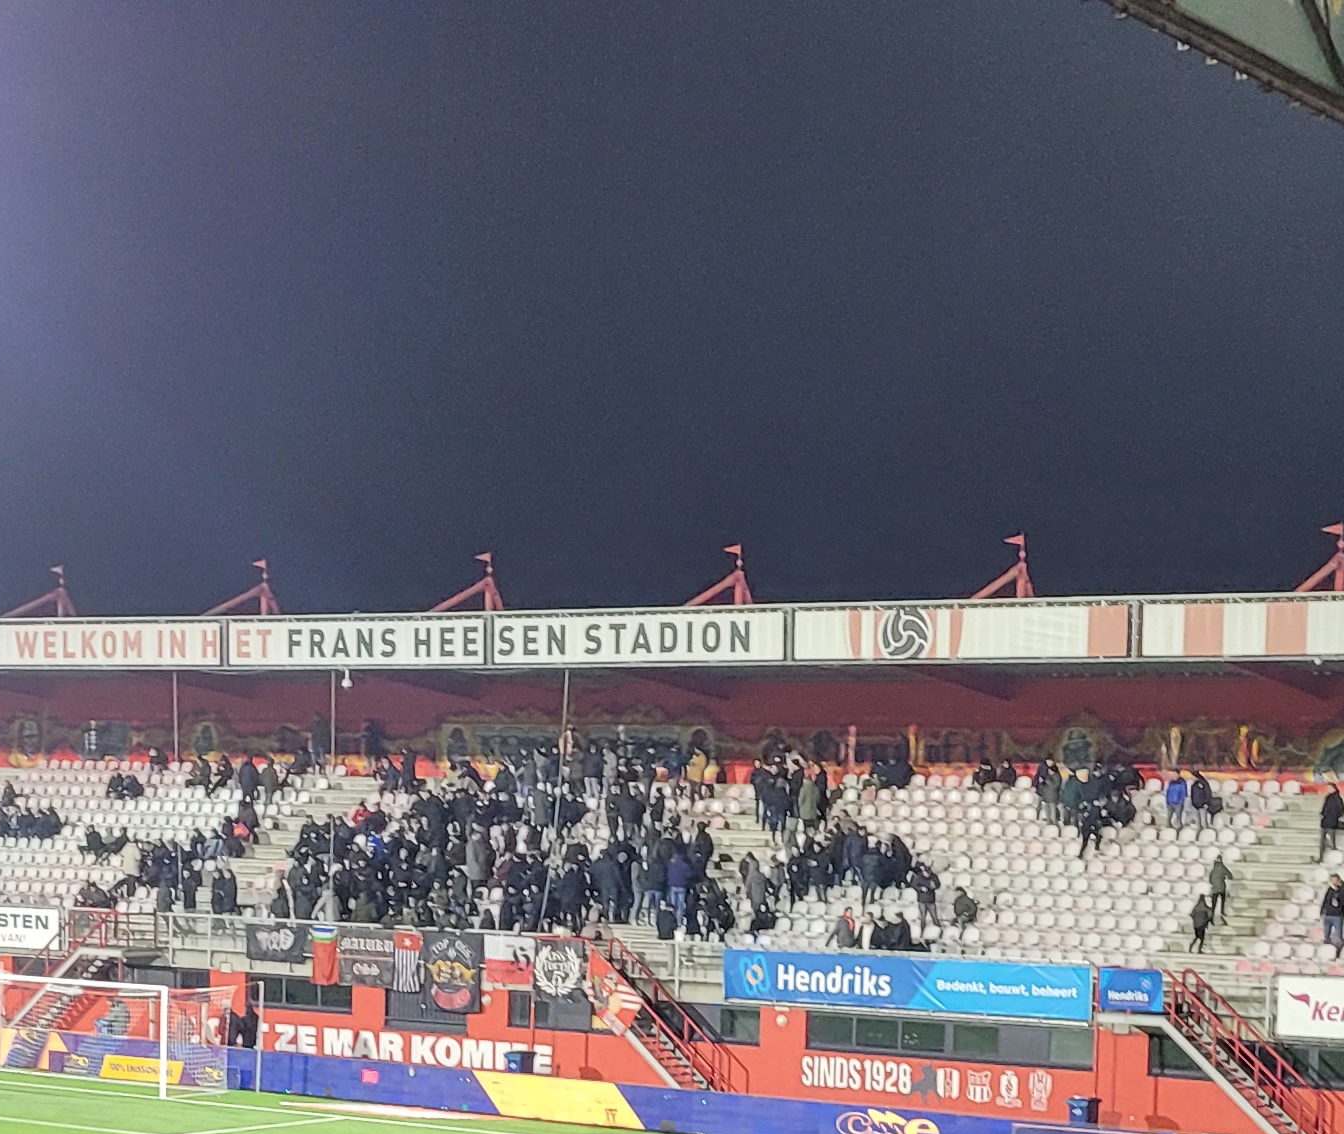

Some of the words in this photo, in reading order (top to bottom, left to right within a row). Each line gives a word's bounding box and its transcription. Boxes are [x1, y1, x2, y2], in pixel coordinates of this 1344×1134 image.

[15, 629, 144, 659] WELKOM
[158, 629, 187, 659] IN
[201, 628, 272, 659] HET
[289, 627, 397, 659] FRANS
[413, 622, 566, 658] HEESEN
[585, 619, 751, 656] STADION
[777, 963, 892, 997] Hendriks
[935, 978, 987, 995] Bedenkt,
[1031, 984, 1078, 999] beheert
[1107, 989, 1150, 1003] Hendriks
[274, 1023, 316, 1055] ZE
[323, 1027, 404, 1062] MAR
[801, 1055, 862, 1091] SINDS
[863, 1058, 913, 1095] 1928
